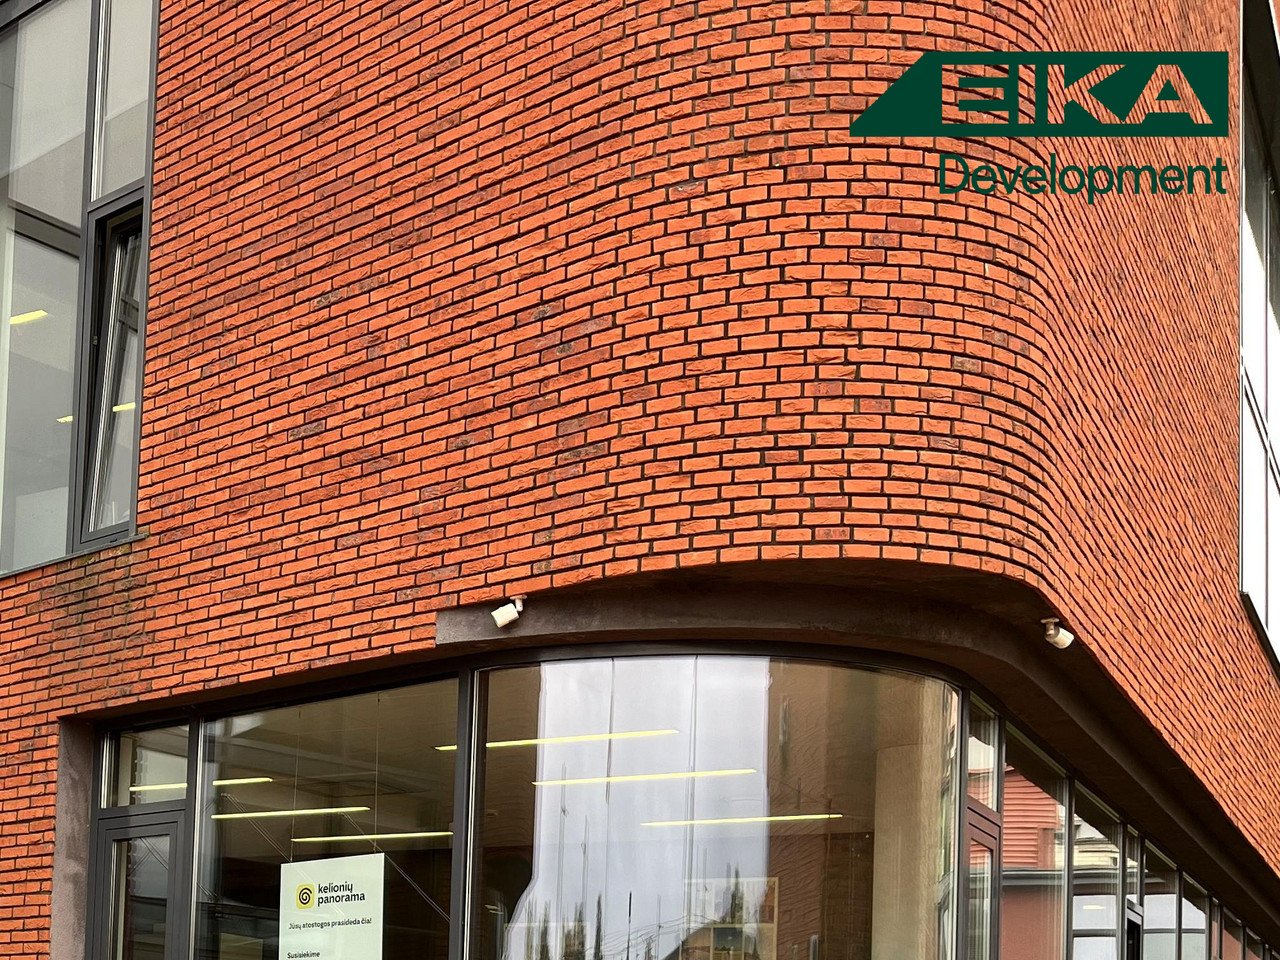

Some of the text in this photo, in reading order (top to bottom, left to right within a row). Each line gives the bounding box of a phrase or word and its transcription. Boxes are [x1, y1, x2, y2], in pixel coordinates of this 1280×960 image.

[318, 881, 353, 894] kelionių
[317, 892, 366, 907] panorama
[302, 921, 331, 929] atostogos
[331, 918, 360, 927] prasideda
[287, 951, 320, 959] Susisiekime
